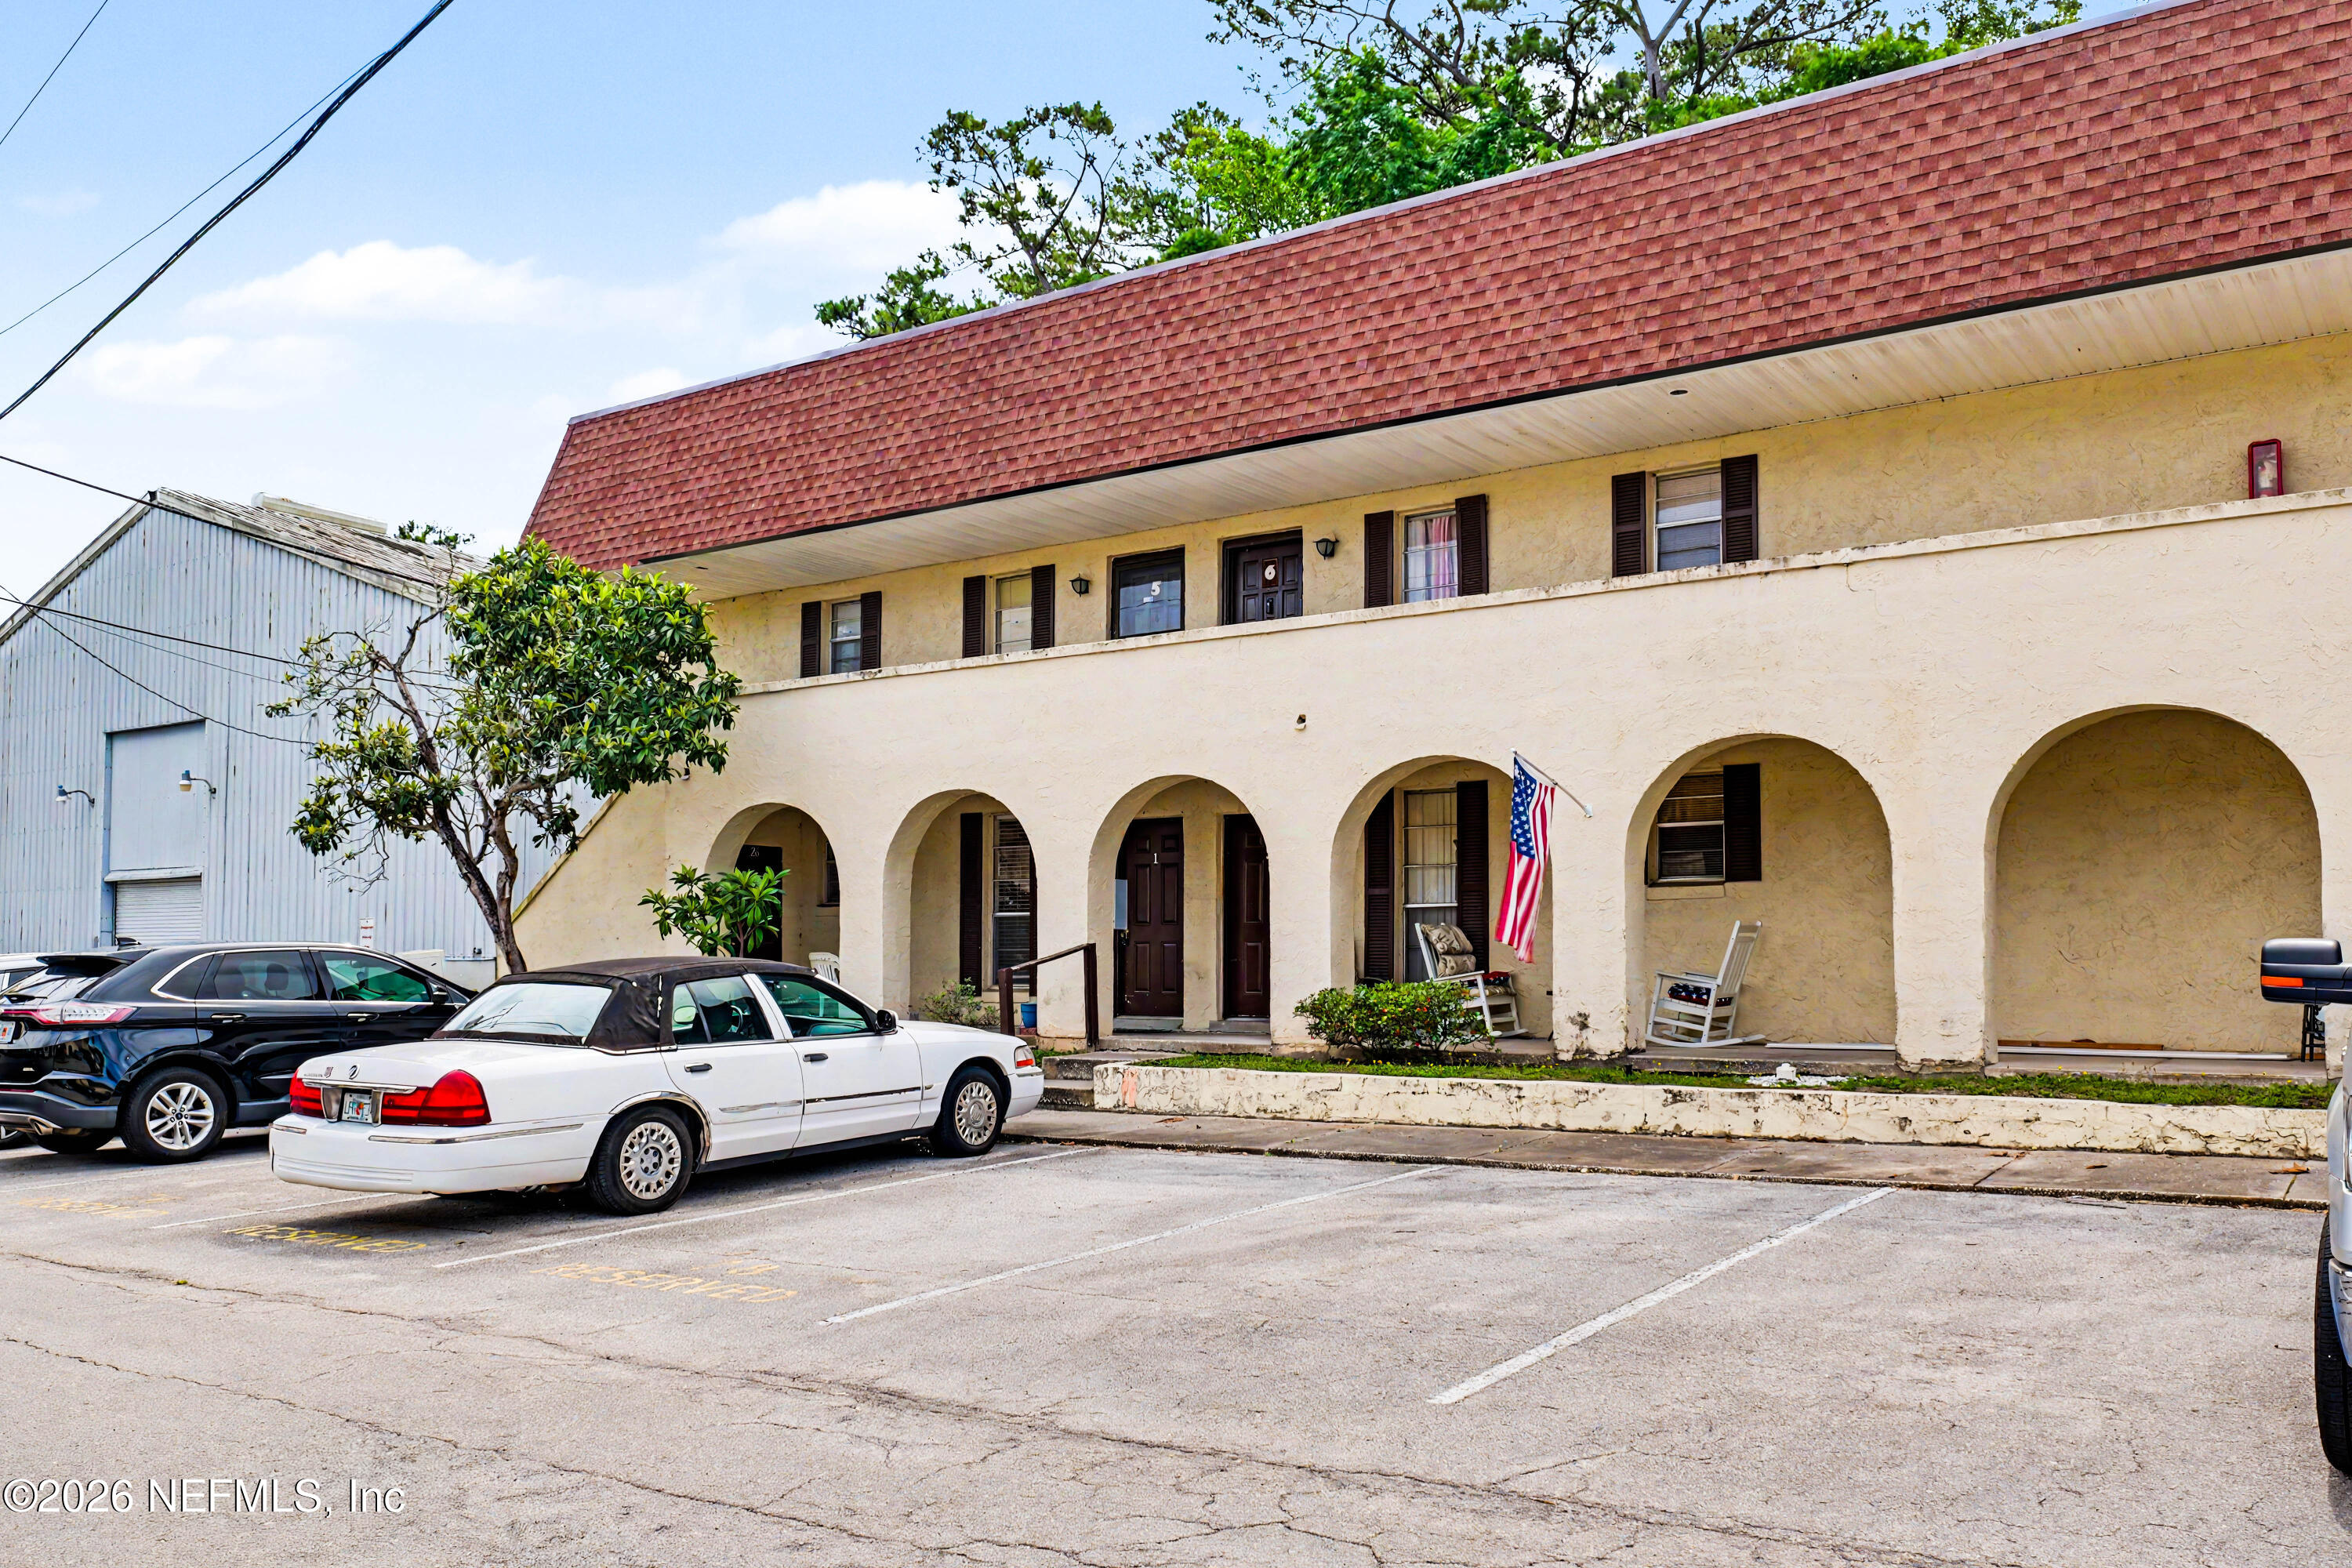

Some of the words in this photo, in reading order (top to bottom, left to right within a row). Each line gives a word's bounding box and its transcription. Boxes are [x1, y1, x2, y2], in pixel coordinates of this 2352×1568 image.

[1265, 564, 1276, 581] 6
[1150, 581, 1162, 596] 5
[1153, 853, 1159, 864] 1
[223, 1224, 427, 1253] RESERVED
[530, 1263, 799, 1303] RESERVED
